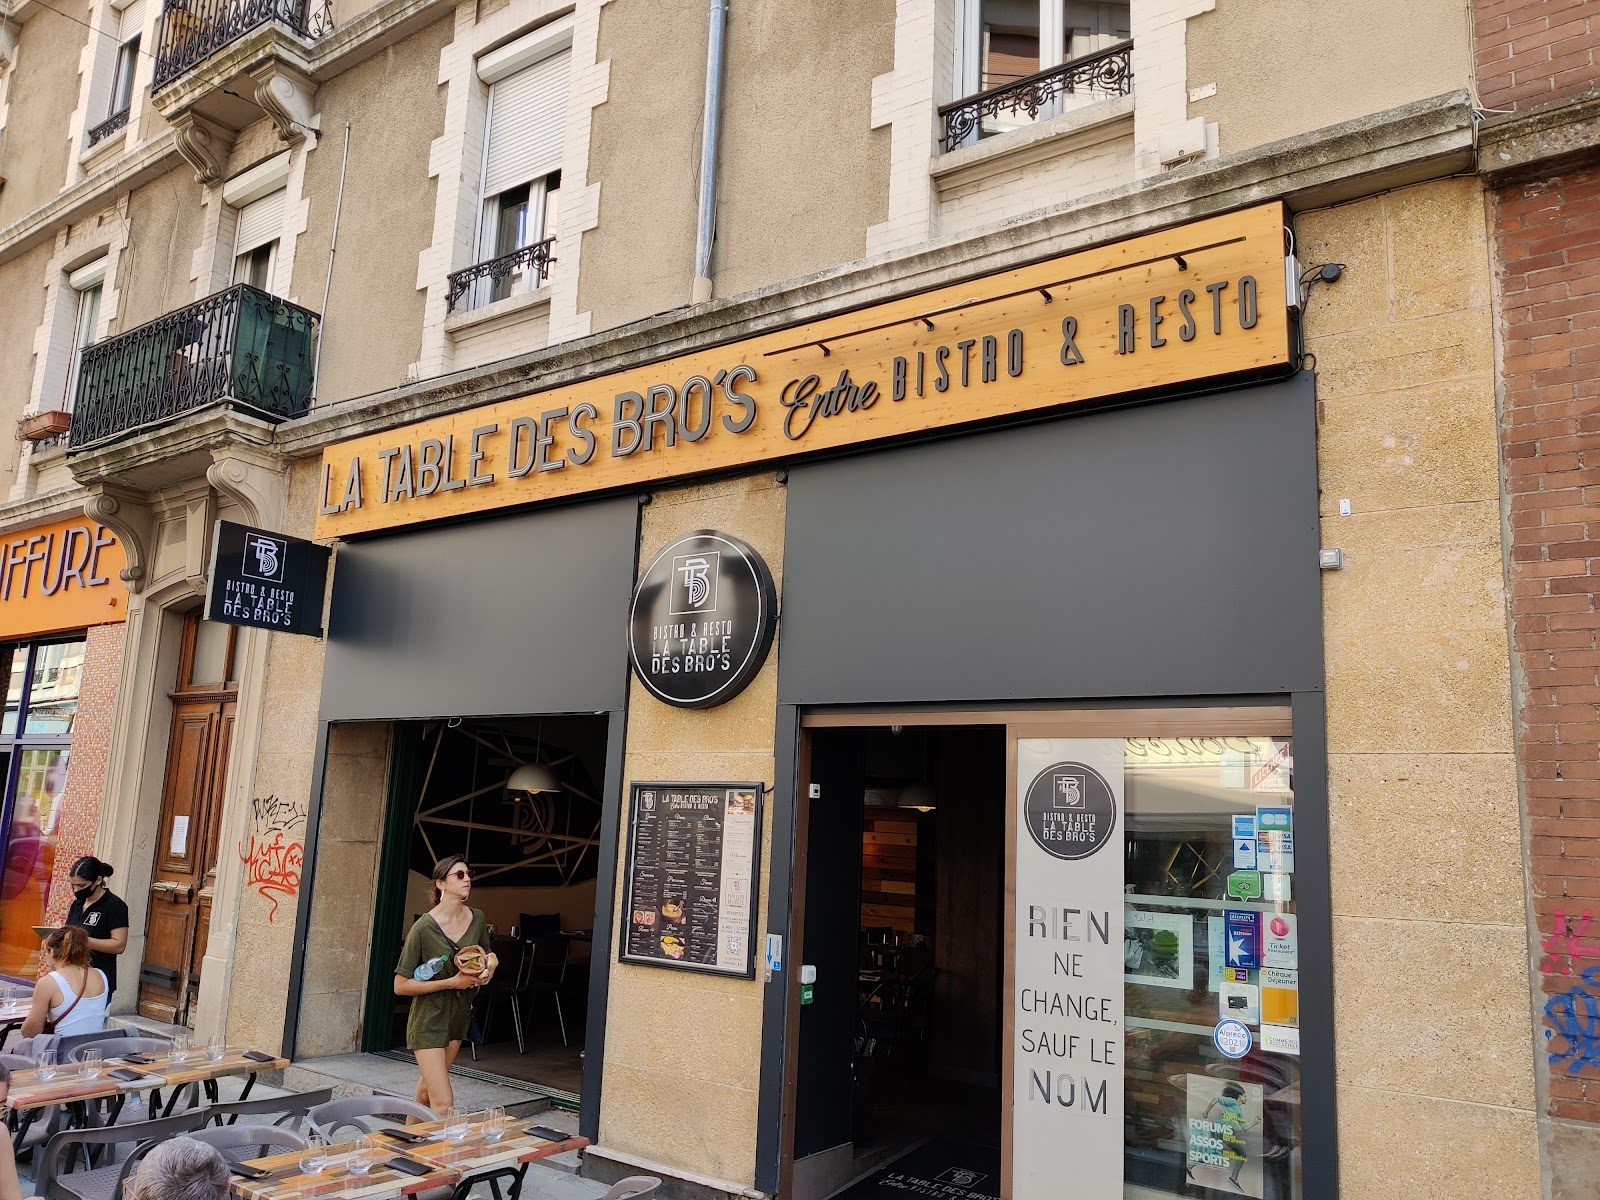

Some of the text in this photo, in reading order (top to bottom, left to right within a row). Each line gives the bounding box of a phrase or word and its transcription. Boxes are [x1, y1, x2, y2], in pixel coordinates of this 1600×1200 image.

[779, 275, 1258, 441] Entre BISTRO & RESTO
[319, 364, 757, 515] LA TABLE DES BRO'S
[226, 579, 294, 602] BISTRO & RESTO
[225, 591, 293, 614] LA TABLE
[223, 602, 292, 625] DES BRO'S
[653, 620, 732, 640] BISTRO & RESTO
[652, 636, 731, 657] LA TABLE
[651, 653, 731, 675] DES BRO'S
[1043, 812, 1096, 823] BISTRO & RESTO
[1043, 821, 1096, 833] LA TABLE
[1043, 830, 1096, 842] DES BRO'S
[1029, 905, 1109, 945] RIEN
[1054, 951, 1083, 978] NE
[1268, 969, 1292, 978] Chèque
[1267, 977, 1297, 985] Déjeuner
[1021, 988, 1117, 1026] CHANGE,
[1021, 1029, 1116, 1066] SAUF LE
[1223, 1037, 1242, 1047] 2021
[1029, 1067, 1107, 1115] NOM
[1189, 1118, 1234, 1135] FORUMS
[1190, 1135, 1224, 1150] ASSOS
[1189, 1150, 1231, 1167] SPORTS
[906, 1177, 943, 1189] TABLE
